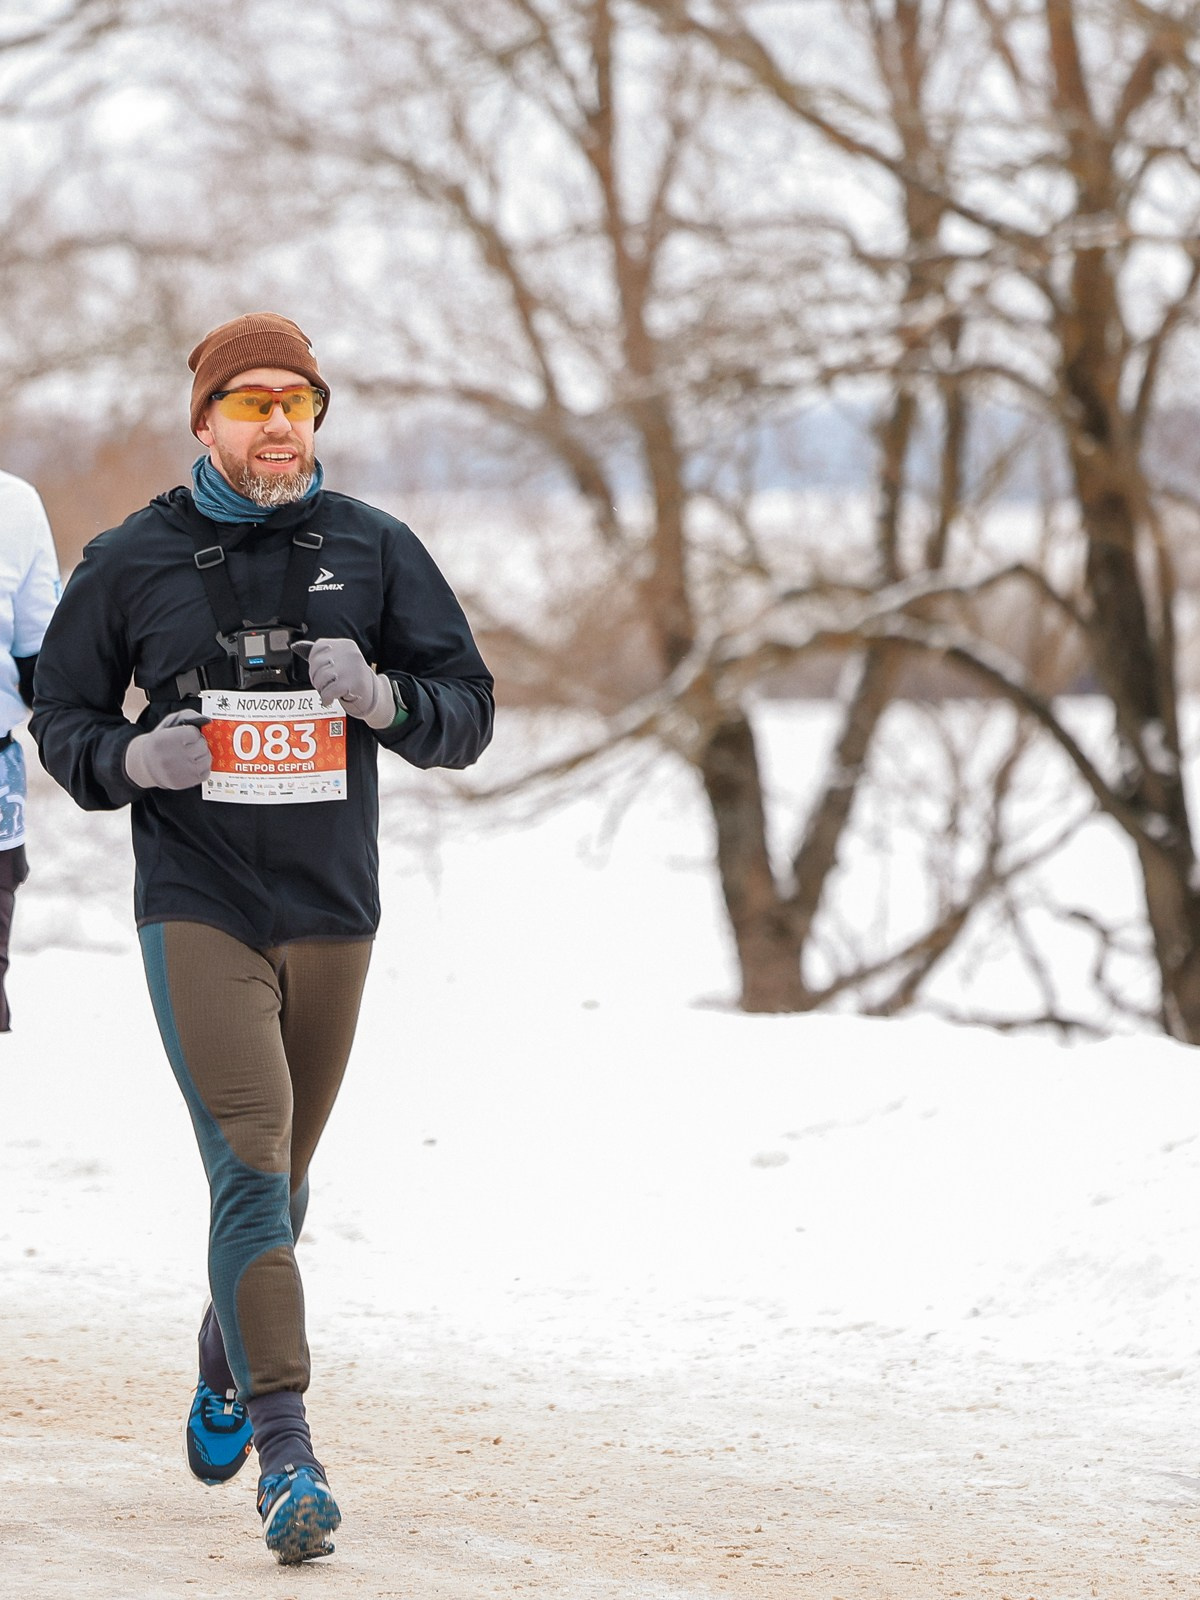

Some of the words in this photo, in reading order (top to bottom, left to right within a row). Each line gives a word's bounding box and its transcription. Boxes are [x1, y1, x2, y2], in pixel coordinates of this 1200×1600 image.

[308, 583, 345, 592] DEMIX
[236, 698, 295, 711] NOVGOROD
[298, 698, 313, 710] ICE
[232, 723, 317, 761] 083
[235, 763, 275, 772] ПЕТРОВ
[277, 761, 315, 772] СЕРГЕЙ
